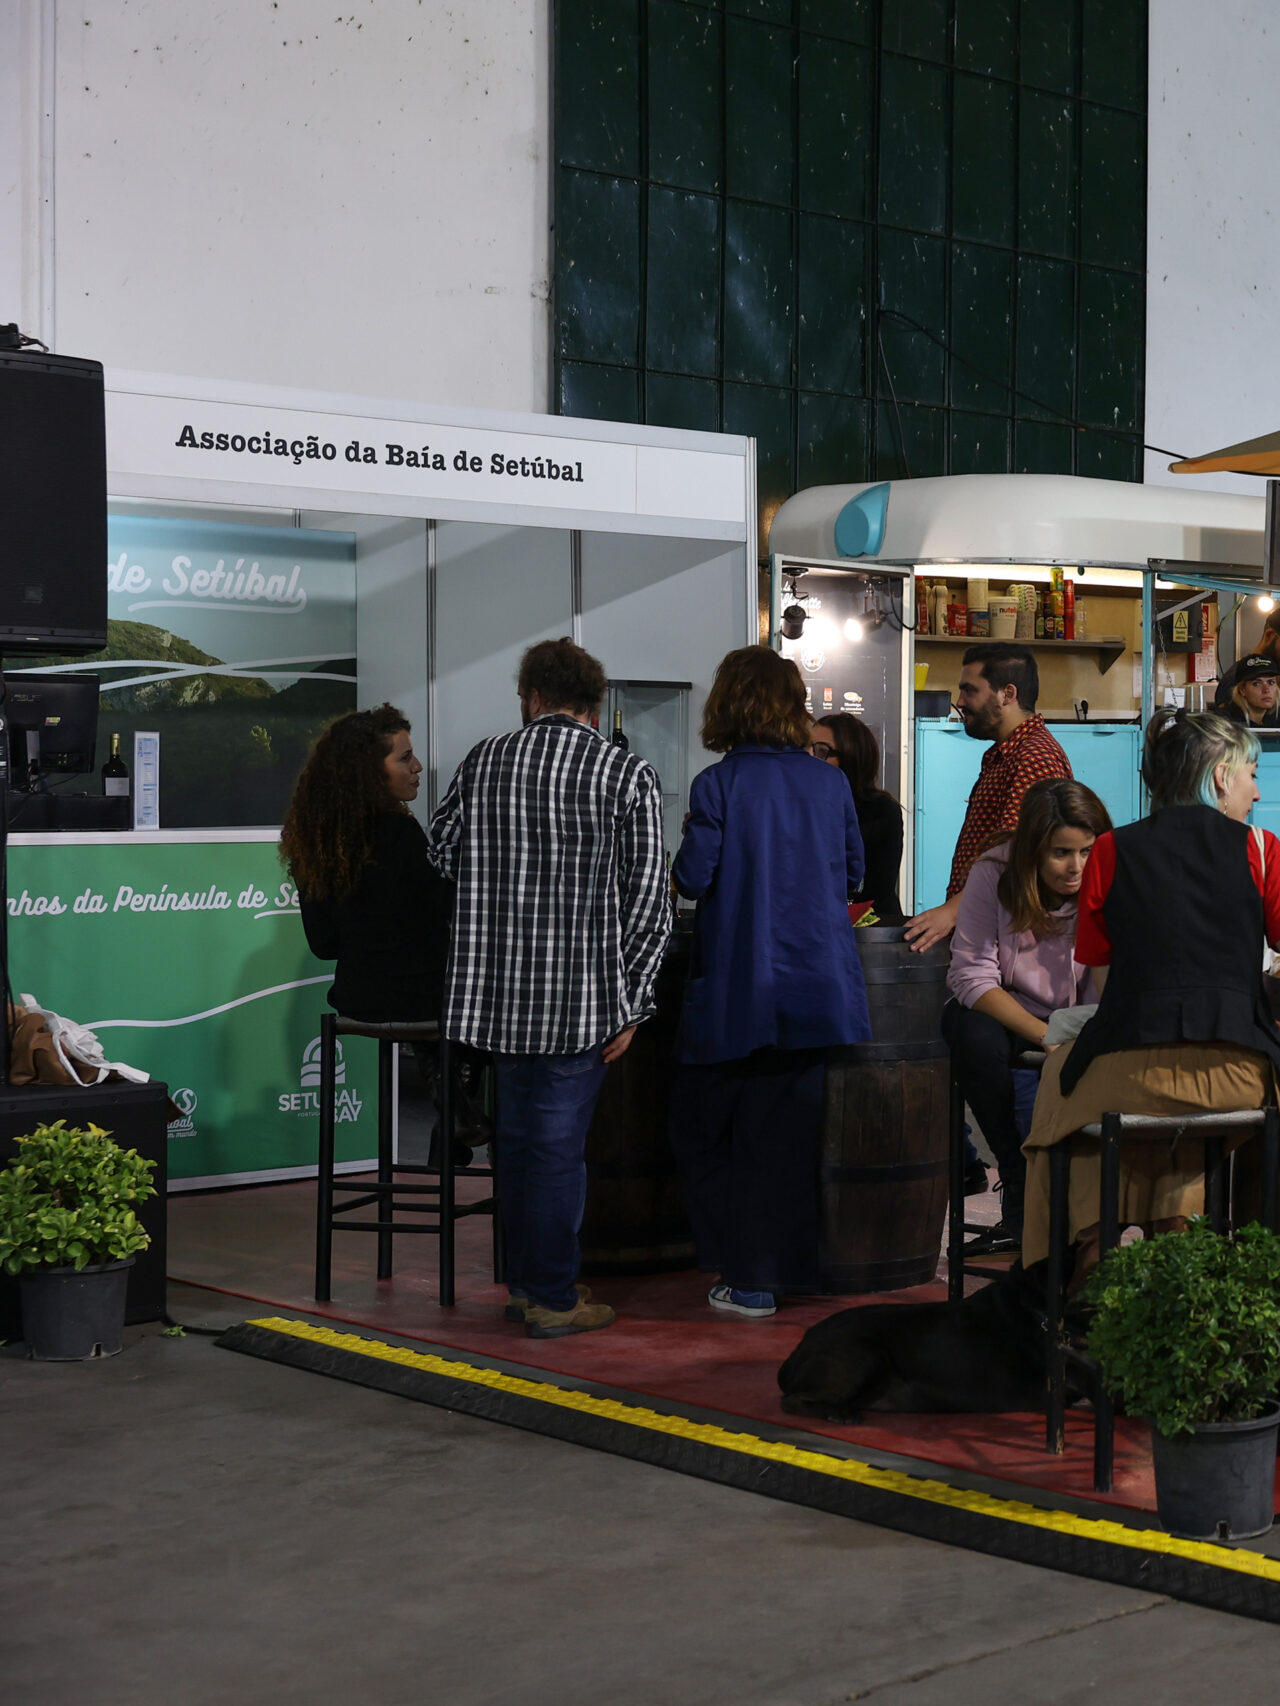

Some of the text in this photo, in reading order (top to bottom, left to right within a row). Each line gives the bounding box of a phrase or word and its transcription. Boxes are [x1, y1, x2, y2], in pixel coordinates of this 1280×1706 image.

[175, 425, 584, 482] Associação da Baía de Setúbal
[107, 552, 307, 604] de Setúbal
[72, 888, 108, 914] da
[113, 884, 232, 912] Península
[237, 884, 268, 908] de
[278, 1088, 362, 1112] SETUAL
